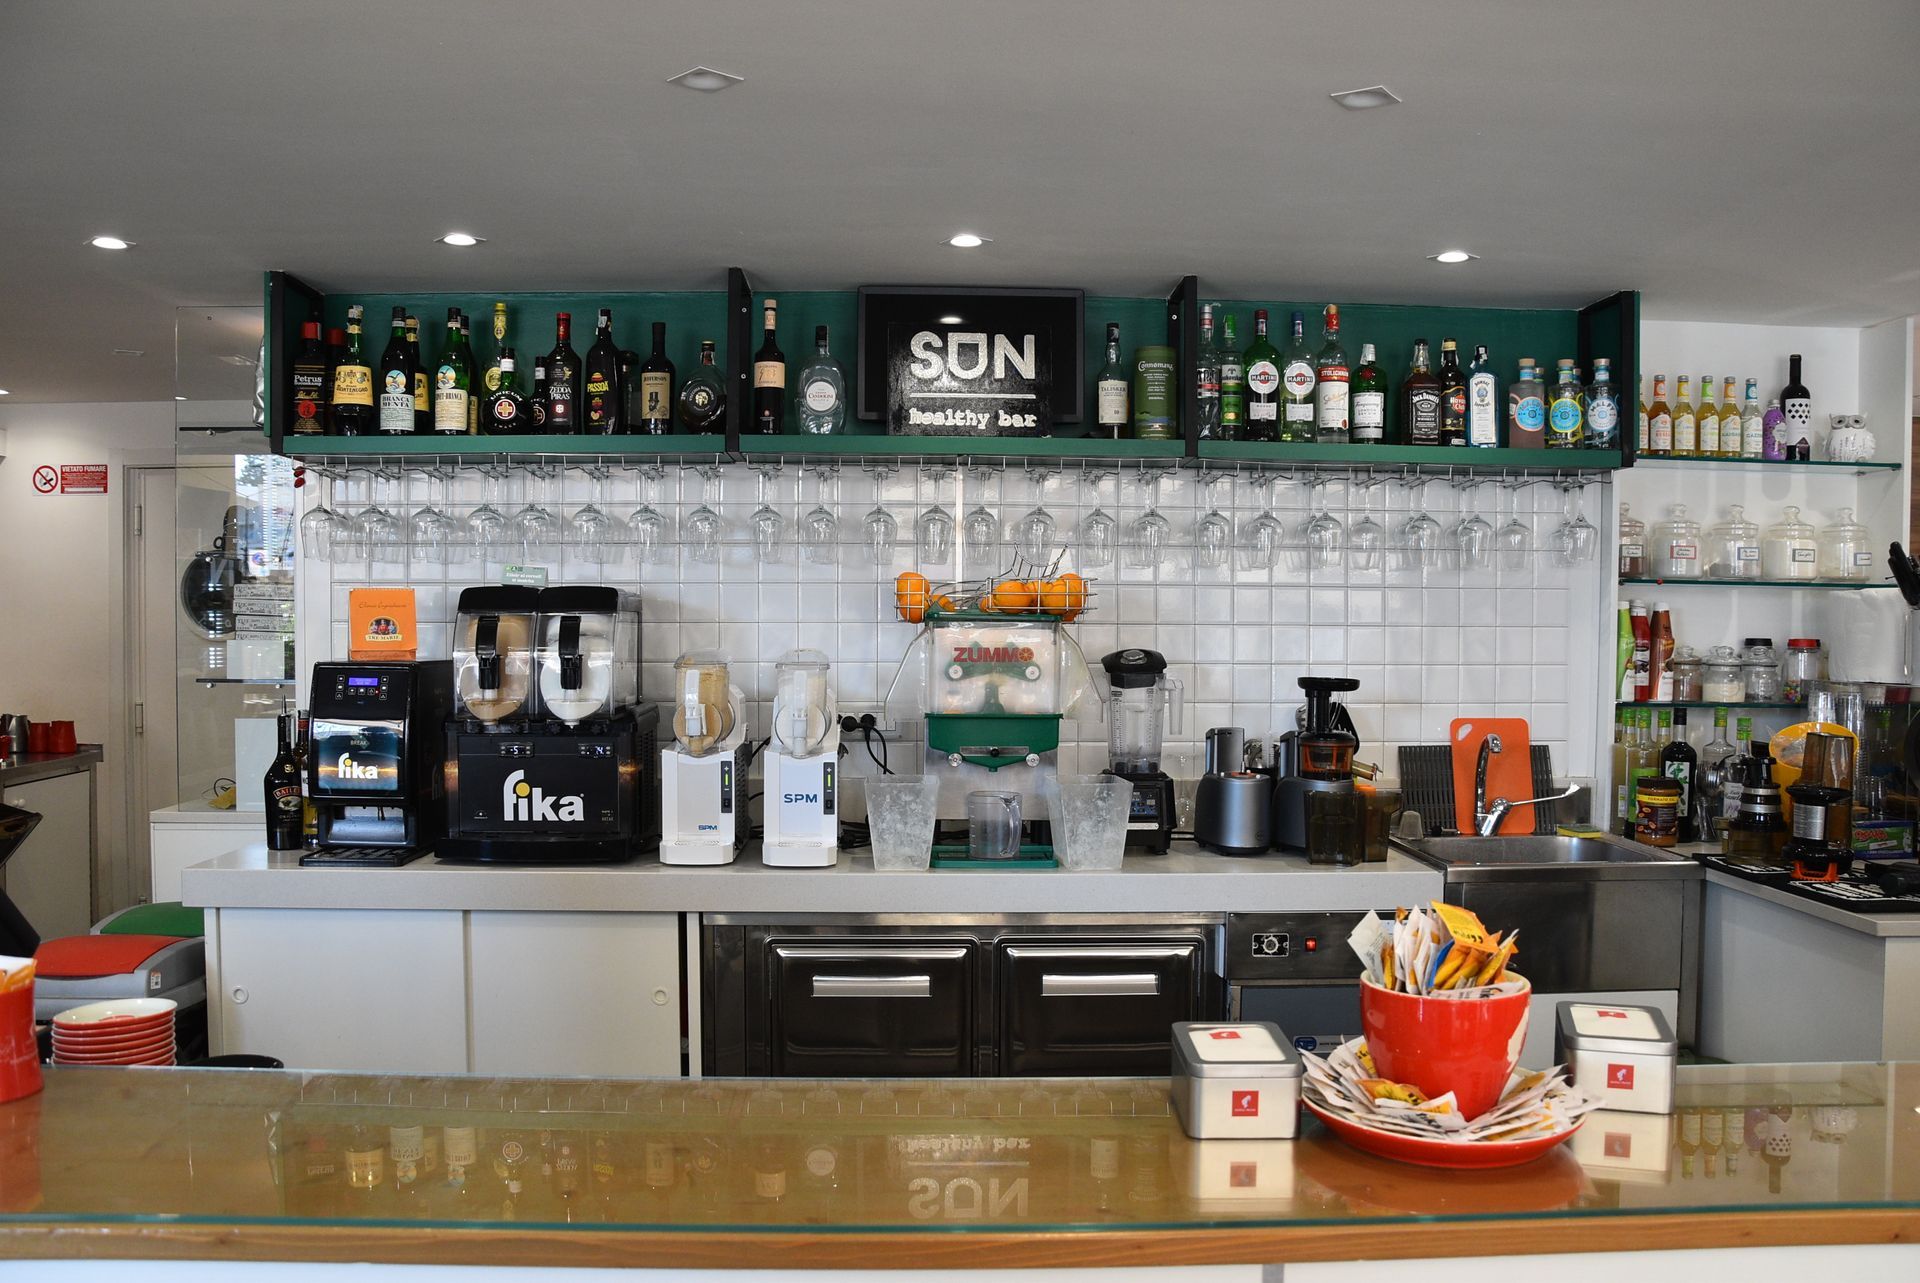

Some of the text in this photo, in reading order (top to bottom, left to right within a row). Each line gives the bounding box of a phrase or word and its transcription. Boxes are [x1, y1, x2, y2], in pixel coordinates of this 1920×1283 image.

[910, 330, 1036, 380] SUN
[294, 374, 322, 383] Petrus
[1412, 394, 1423, 403] JACK
[909, 408, 1037, 429] healthy bar
[953, 647, 1035, 663] ZUMMO
[337, 752, 378, 780] fika
[503, 769, 584, 822] fika
[783, 793, 818, 803] SPM
